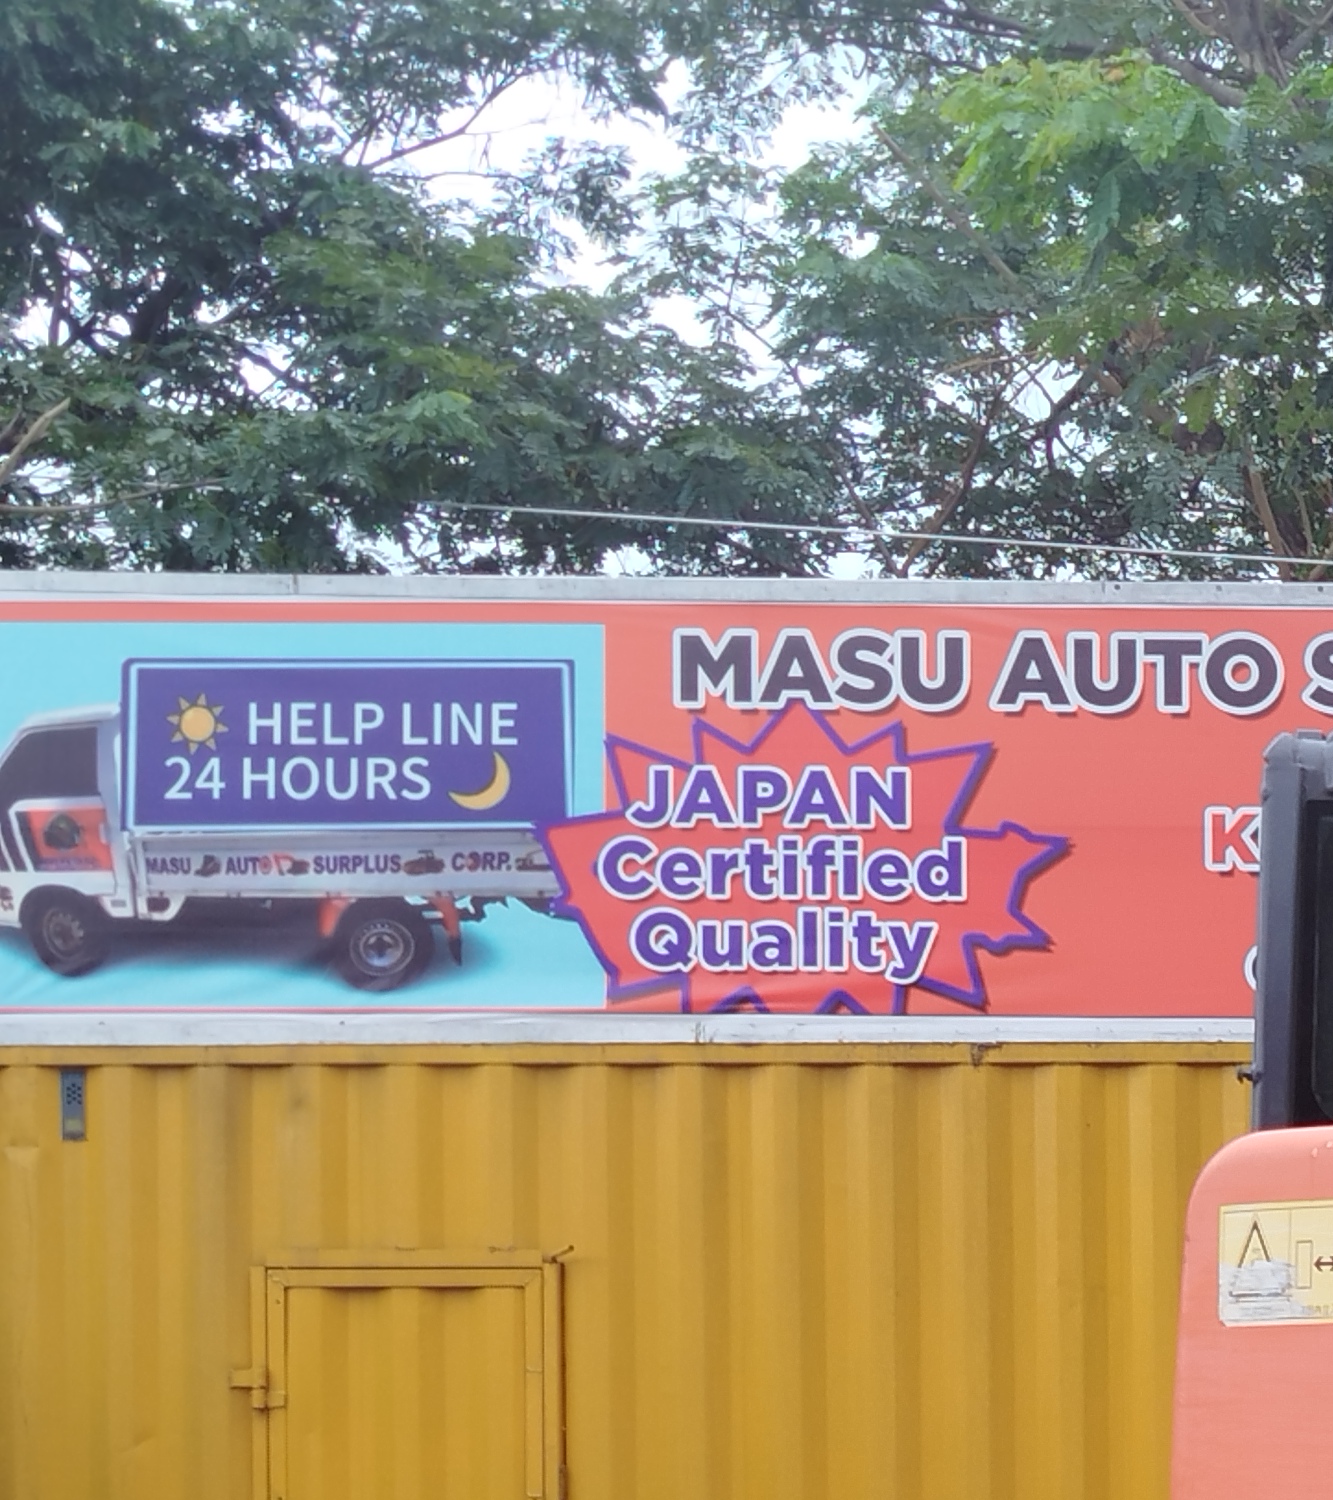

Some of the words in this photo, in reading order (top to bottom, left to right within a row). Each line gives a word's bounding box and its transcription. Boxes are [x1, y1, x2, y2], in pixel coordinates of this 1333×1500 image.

[673, 628, 969, 710] MASU
[991, 630, 1283, 714] AUTO
[247, 702, 384, 746] HELP
[402, 702, 518, 746] LINE
[164, 755, 225, 801] 24
[241, 756, 432, 802] HOURS
[626, 765, 911, 829] JAPAN
[145, 856, 191, 875] MASU
[313, 854, 401, 874] SURPLUS
[599, 836, 967, 901] Certified
[630, 907, 937, 983] Quality
